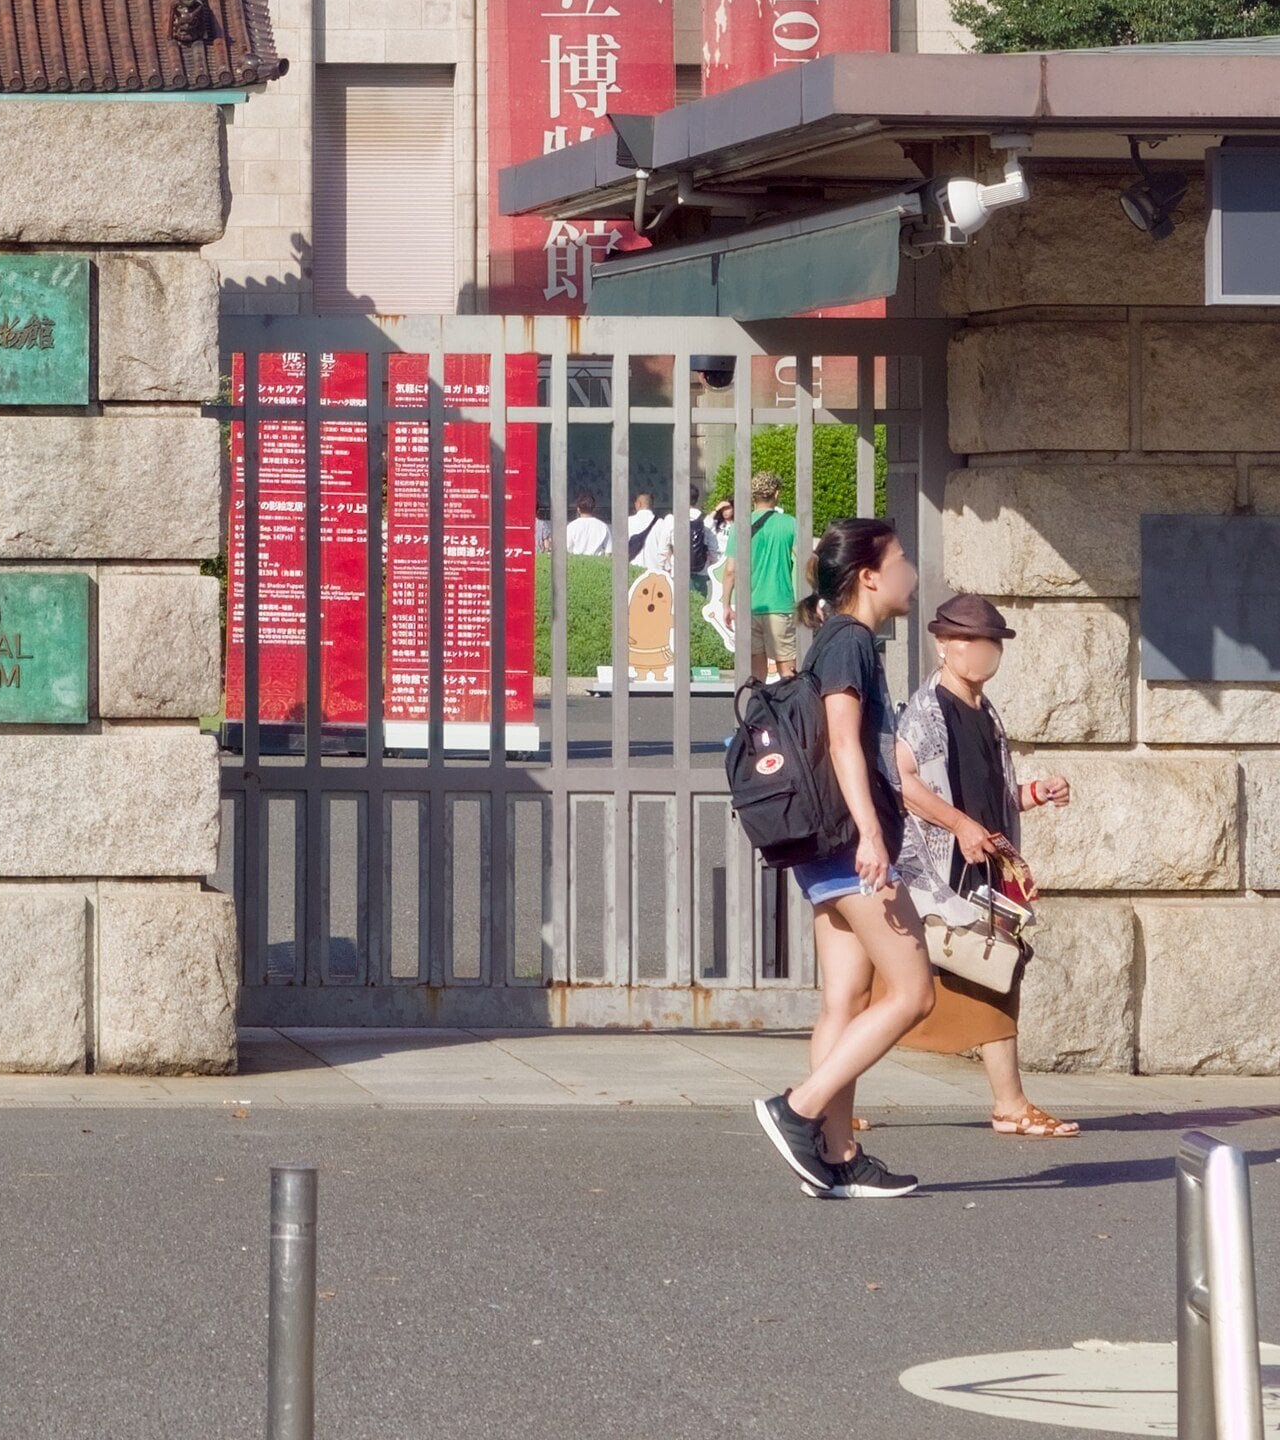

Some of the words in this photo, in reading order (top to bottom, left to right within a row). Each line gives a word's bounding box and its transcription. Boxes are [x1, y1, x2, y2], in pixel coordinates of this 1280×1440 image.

[238, 383, 307, 395] スシャルツア
[395, 383, 462, 394] 気軽にヨガ
[393, 534, 478, 546] ボランテアによる
[391, 673, 477, 685] 博物館でシネマ
